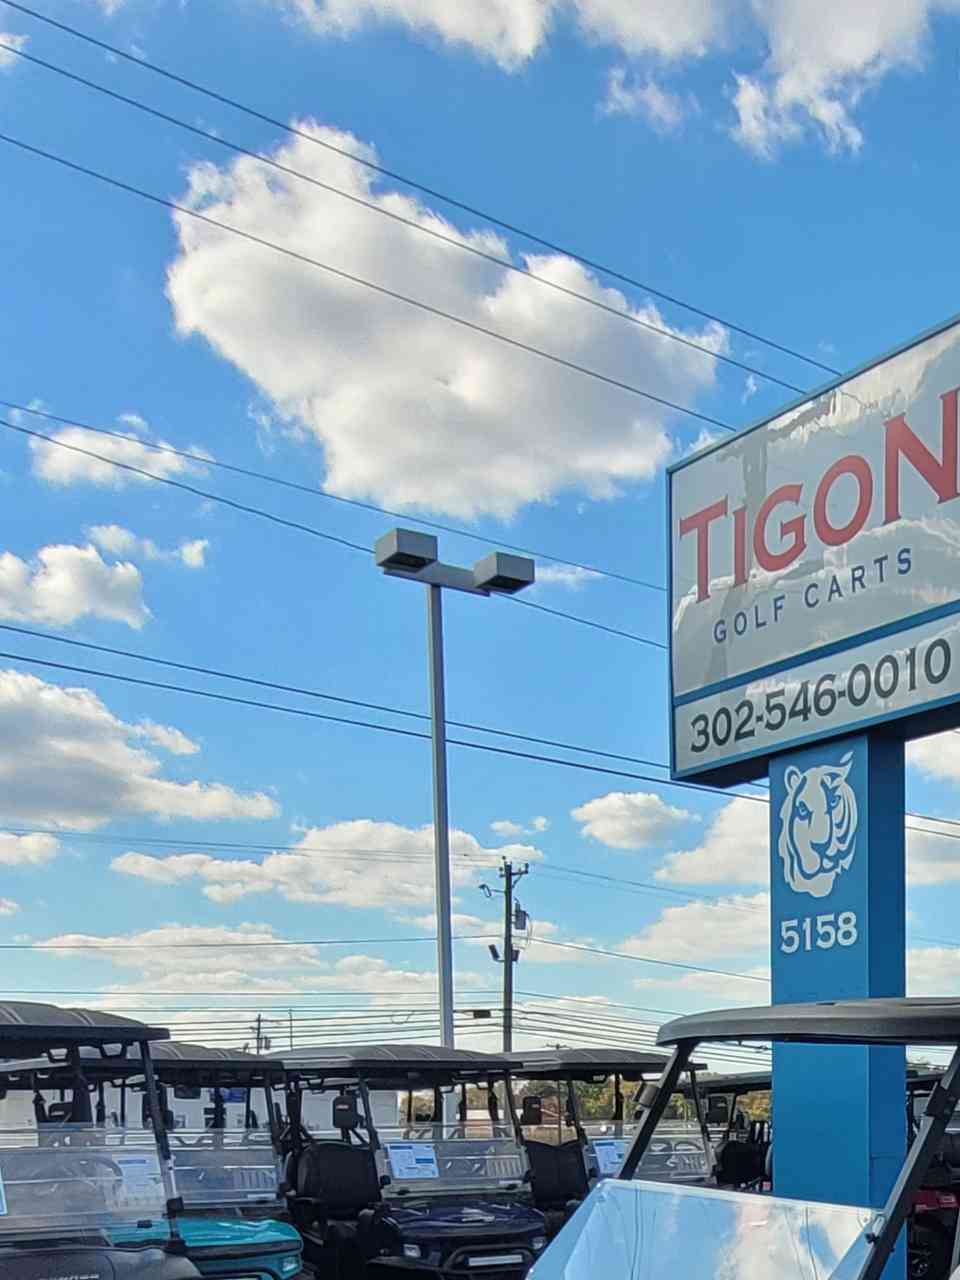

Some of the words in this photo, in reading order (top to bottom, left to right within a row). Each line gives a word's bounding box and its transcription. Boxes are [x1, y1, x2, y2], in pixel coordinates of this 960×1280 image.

[713, 595, 786, 645] GOLF
[803, 547, 913, 609] CARTS
[690, 638, 952, 753] 302-546-0010
[780, 911, 858, 954] 5158
